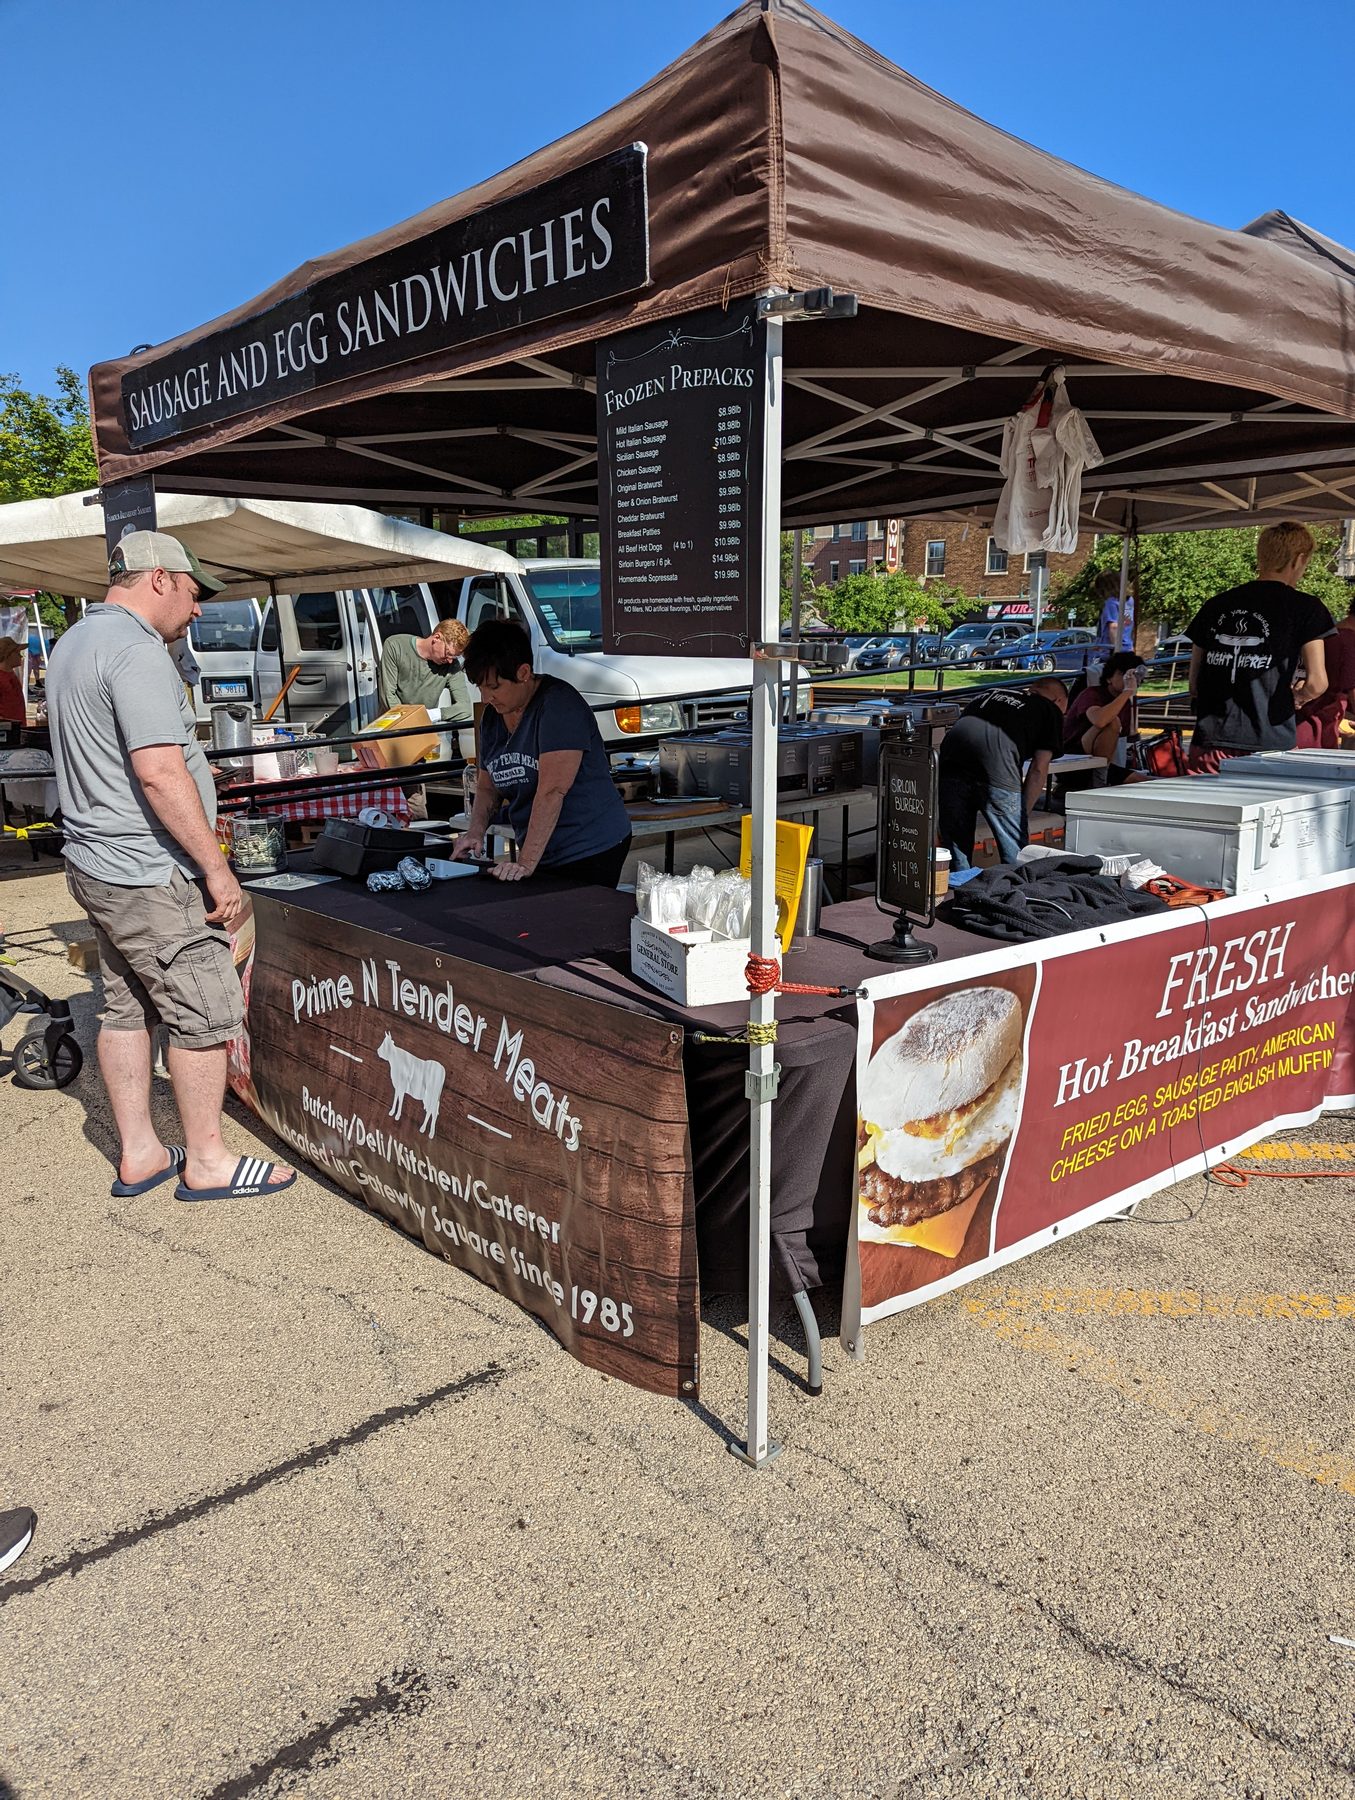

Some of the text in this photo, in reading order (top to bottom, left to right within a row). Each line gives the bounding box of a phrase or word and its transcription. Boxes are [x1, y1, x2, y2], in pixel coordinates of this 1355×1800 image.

[129, 197, 613, 431] SAUSAGE AND EGG SANDWICHES
[616, 405, 741, 435] Mild Italian Sausage $8.98lb
[616, 420, 741, 449] Hot Italian Sausage $8.98lb
[616, 435, 741, 462] Sicilian Sausage $10.98lb
[616, 452, 740, 477] Chicken Sausage $8.98lb
[617, 468, 741, 494] Original Bratwurst $8.98lb
[618, 486, 742, 508] Beer & Onion Bratwurst $9.98lb
[618, 504, 741, 524] Cheddar Bratwurst $9.98lb
[618, 520, 742, 538] Breakfast Patties $9.98lb
[625, 544, 638, 552] Beef
[638, 544, 648, 552] Hot
[648, 543, 662, 553] Dogs
[673, 542, 679, 552] (4
[680, 542, 686, 550] to
[687, 540, 694, 550] 1)
[714, 537, 741, 548] $10.98lb
[618, 560, 634, 568] Sirloin
[635, 559, 656, 569] Burgers
[659, 558, 664, 566] 6
[664, 558, 672, 568] pk.
[712, 554, 740, 564] $14.98pk
[618, 570, 740, 584] Homemade Sopressata $19.98lb
[697, 596, 712, 604] quality
[1206, 650, 1272, 669] RIGHT HERE!
[894, 796, 925, 816] BURGERS
[892, 838, 916, 854] 6 PACK
[636, 944, 678, 976] GENERAL STORE
[1155, 921, 1297, 1020] FRESH
[291, 958, 584, 1152] Prime N Tender Meats
[1054, 1053, 1114, 1108] Hot
[1116, 1008, 1239, 1082] Breakfast
[1060, 1021, 1336, 1152] FRIED EGG, SAUSAGE PATTY, AMERICAN
[1050, 1047, 1335, 1183] CHEESE ON A TOASTED ENGLISH MUFFIN
[232, 1186, 260, 1195] adidas
[275, 1111, 635, 1338] Located in Gateway Square Since 1985
